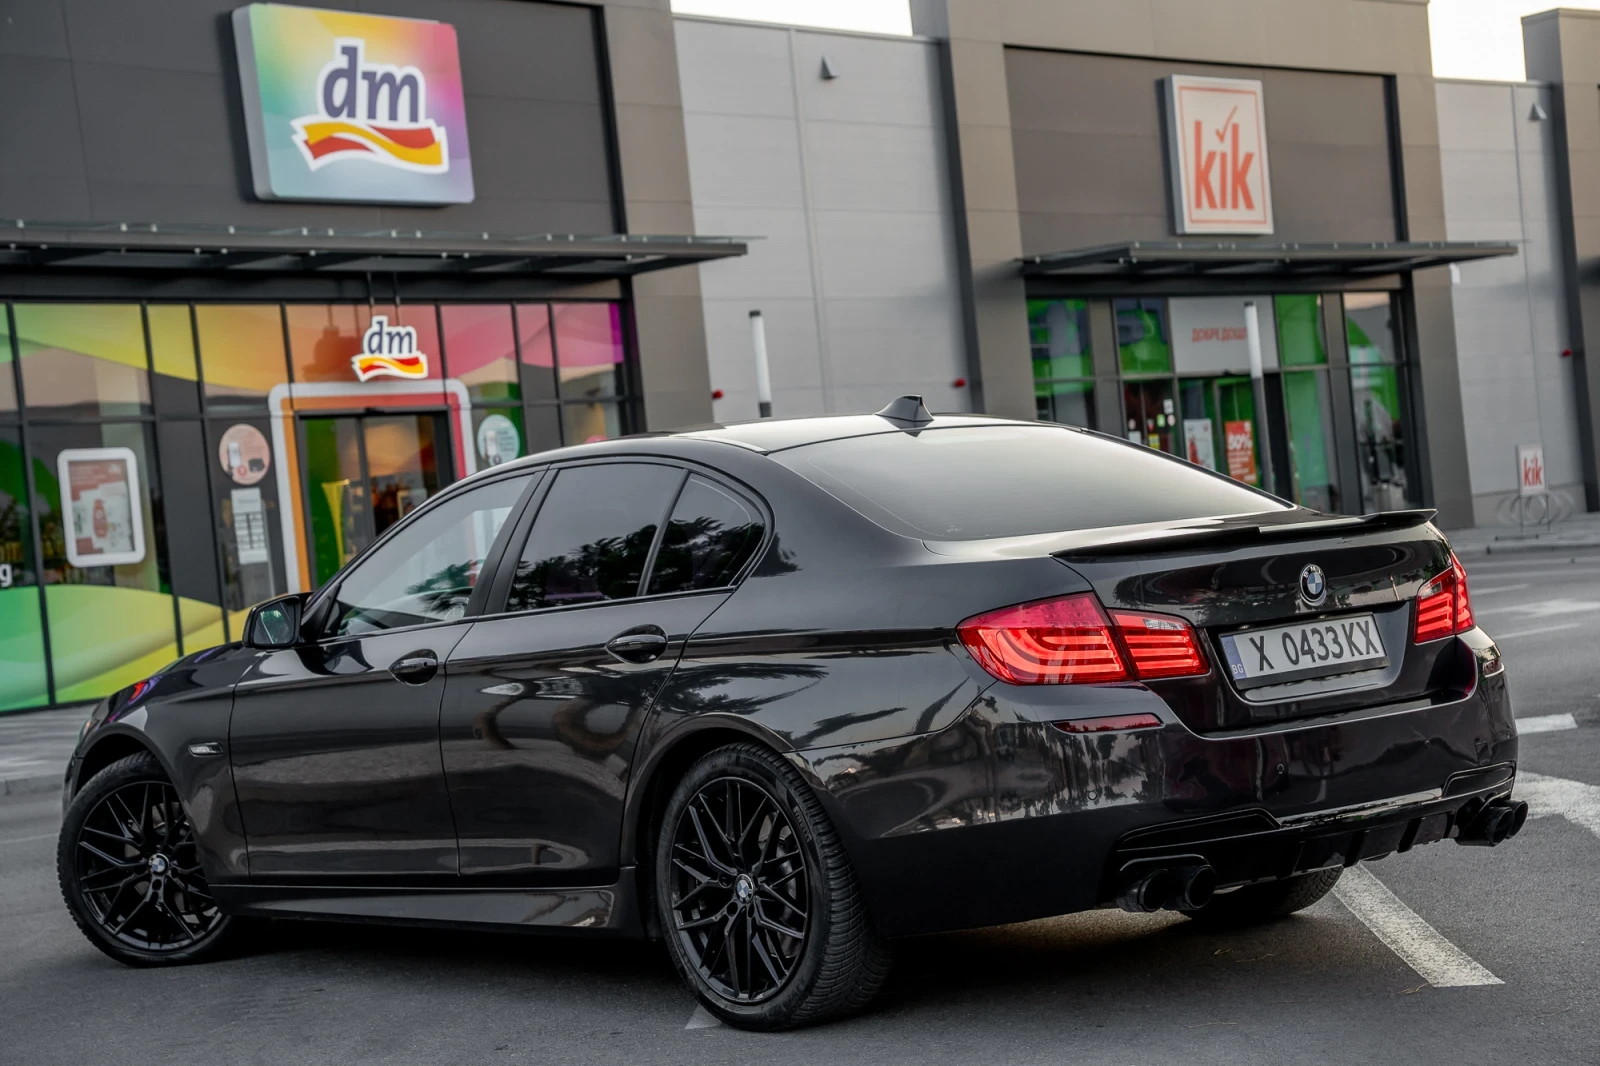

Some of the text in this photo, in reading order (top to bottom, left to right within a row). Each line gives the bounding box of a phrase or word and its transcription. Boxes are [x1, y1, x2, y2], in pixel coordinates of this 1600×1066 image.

[323, 45, 419, 123] dm
[1194, 106, 1255, 211] kik
[367, 320, 413, 355] dm
[1523, 455, 1543, 486] kik
[1231, 663, 1244, 675] BG
